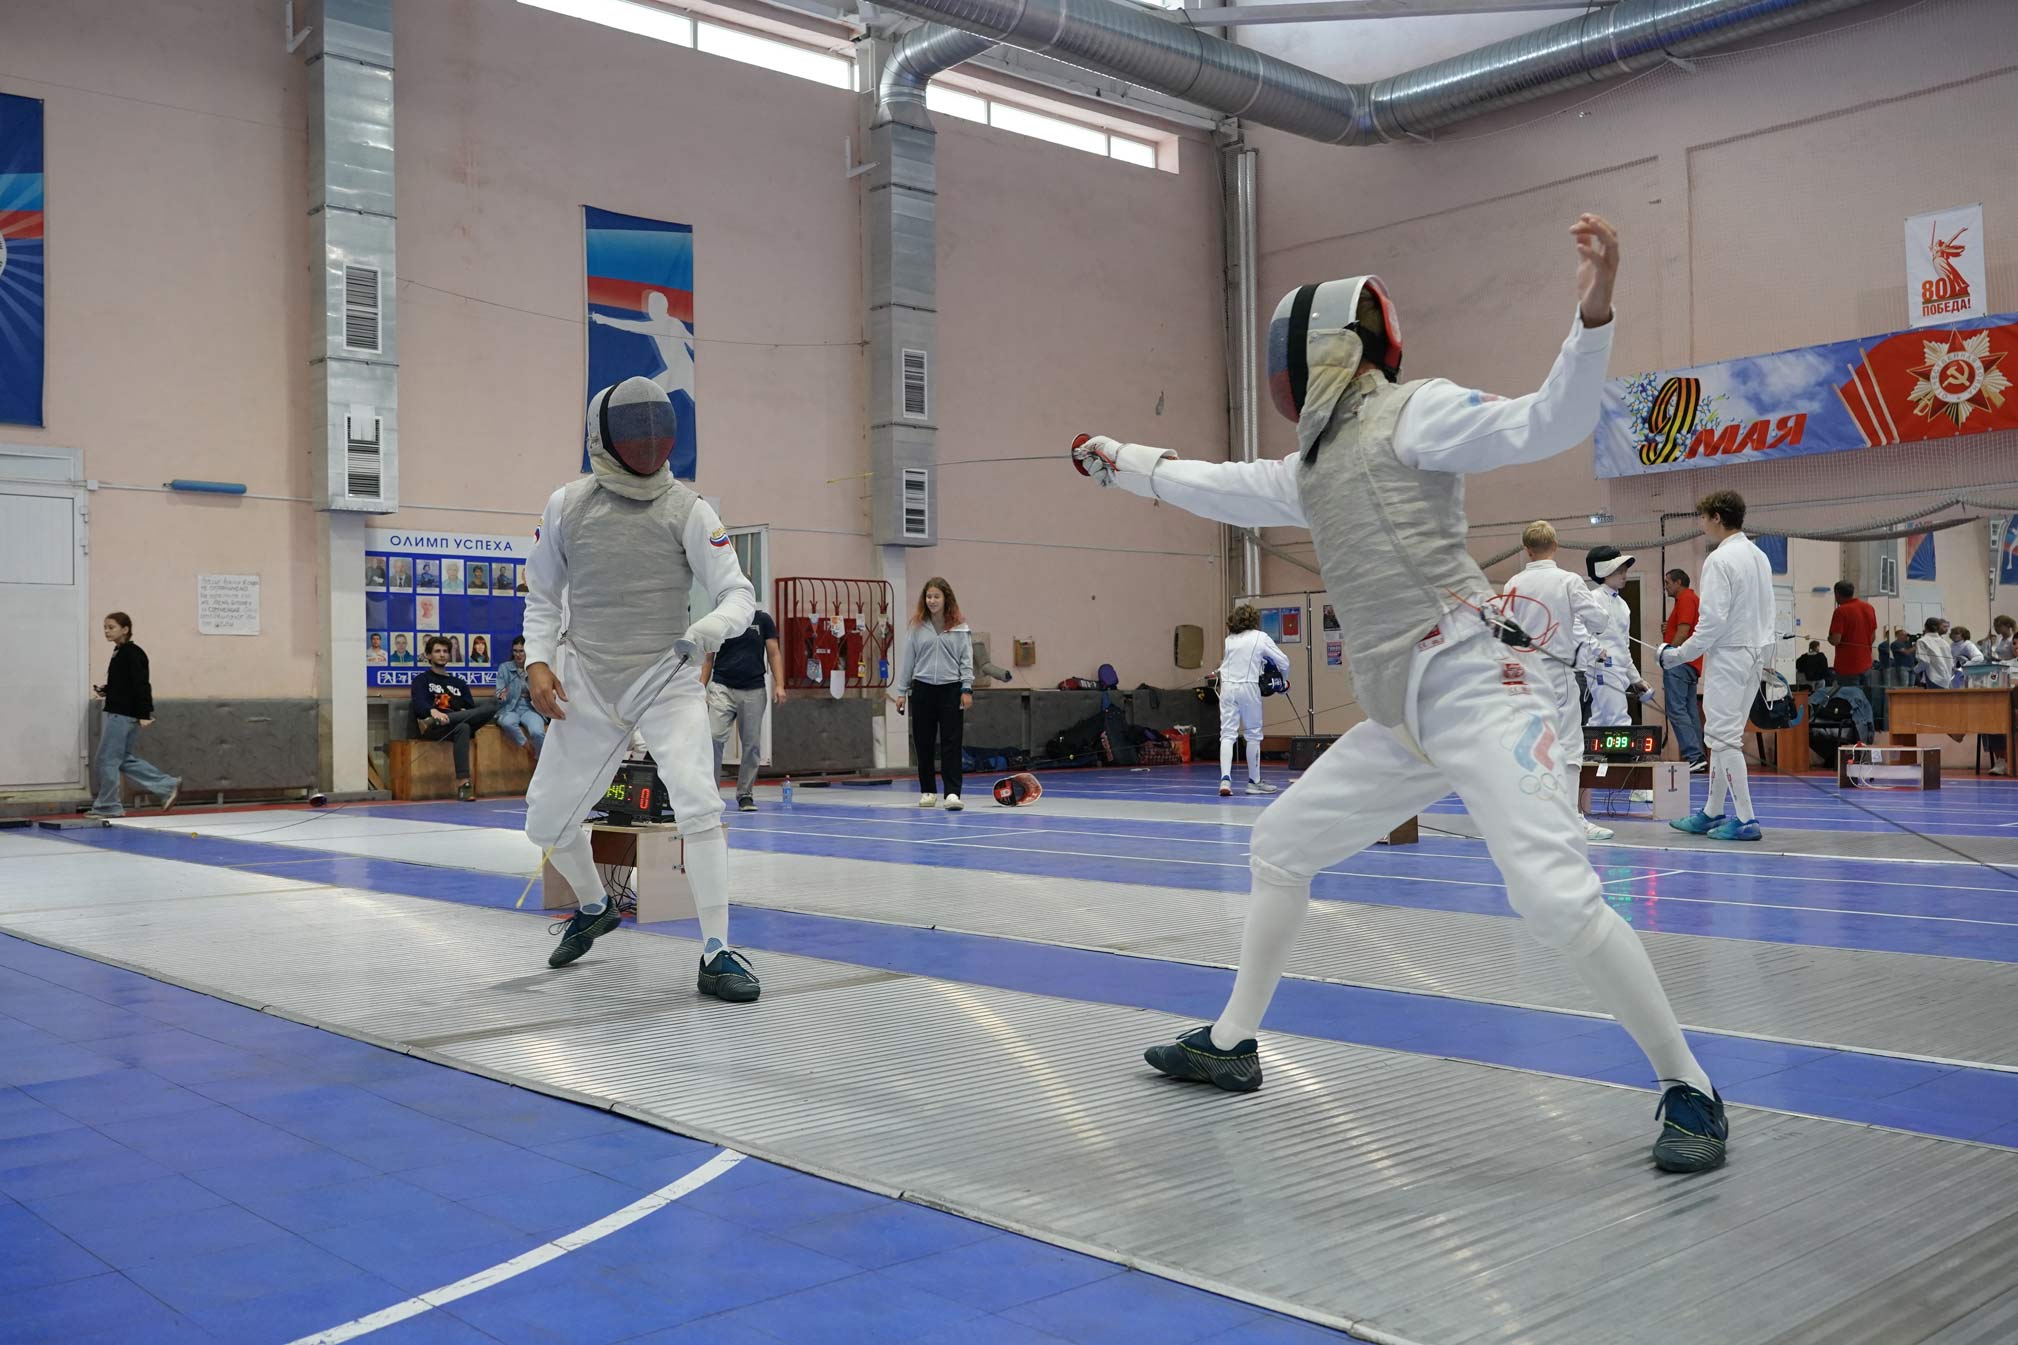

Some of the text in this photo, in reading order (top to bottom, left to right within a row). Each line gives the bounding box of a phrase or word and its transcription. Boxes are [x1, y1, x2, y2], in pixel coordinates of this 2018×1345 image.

[1921, 277, 1949, 302] 80
[1922, 298, 1971, 317] ПОБЕДА!
[1639, 377, 1808, 465] 9 МАЯ
[390, 535, 513, 552] ОЛИМП УСПЕХА
[1593, 736, 1654, 752] 1 0:39 3
[640, 788, 651, 809] 0
